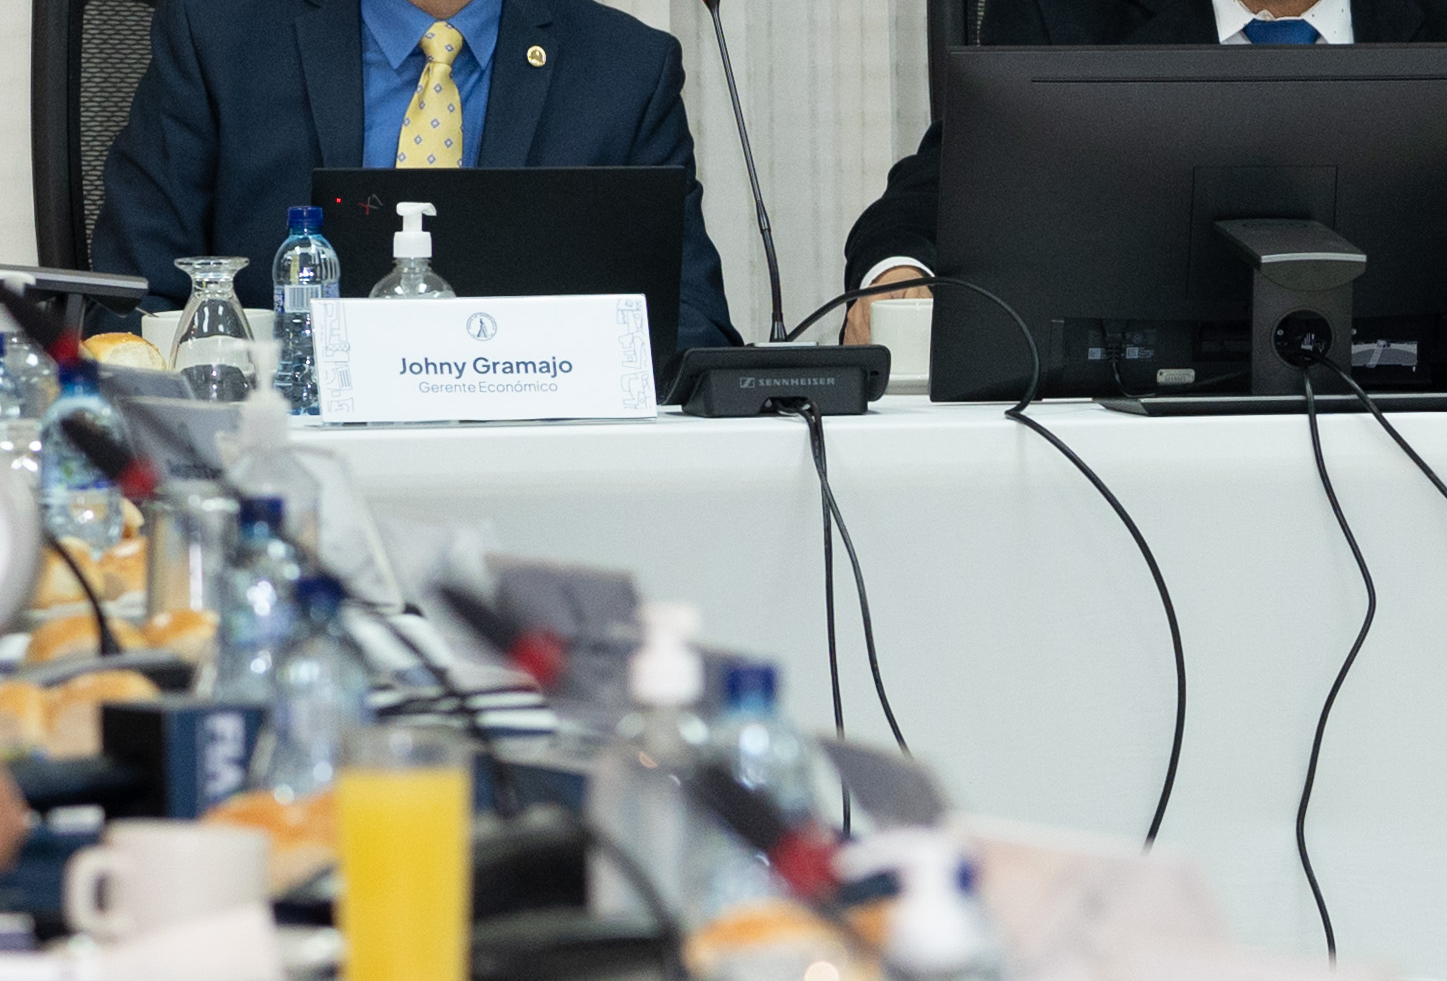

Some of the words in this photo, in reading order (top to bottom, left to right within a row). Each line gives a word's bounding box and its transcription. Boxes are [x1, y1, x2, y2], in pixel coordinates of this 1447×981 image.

[399, 356, 467, 379] Johny
[472, 354, 574, 379] Gramajo
[418, 381, 477, 394] Gerente
[479, 377, 558, 393] Económico
[758, 376, 836, 387] SENNHEISER
